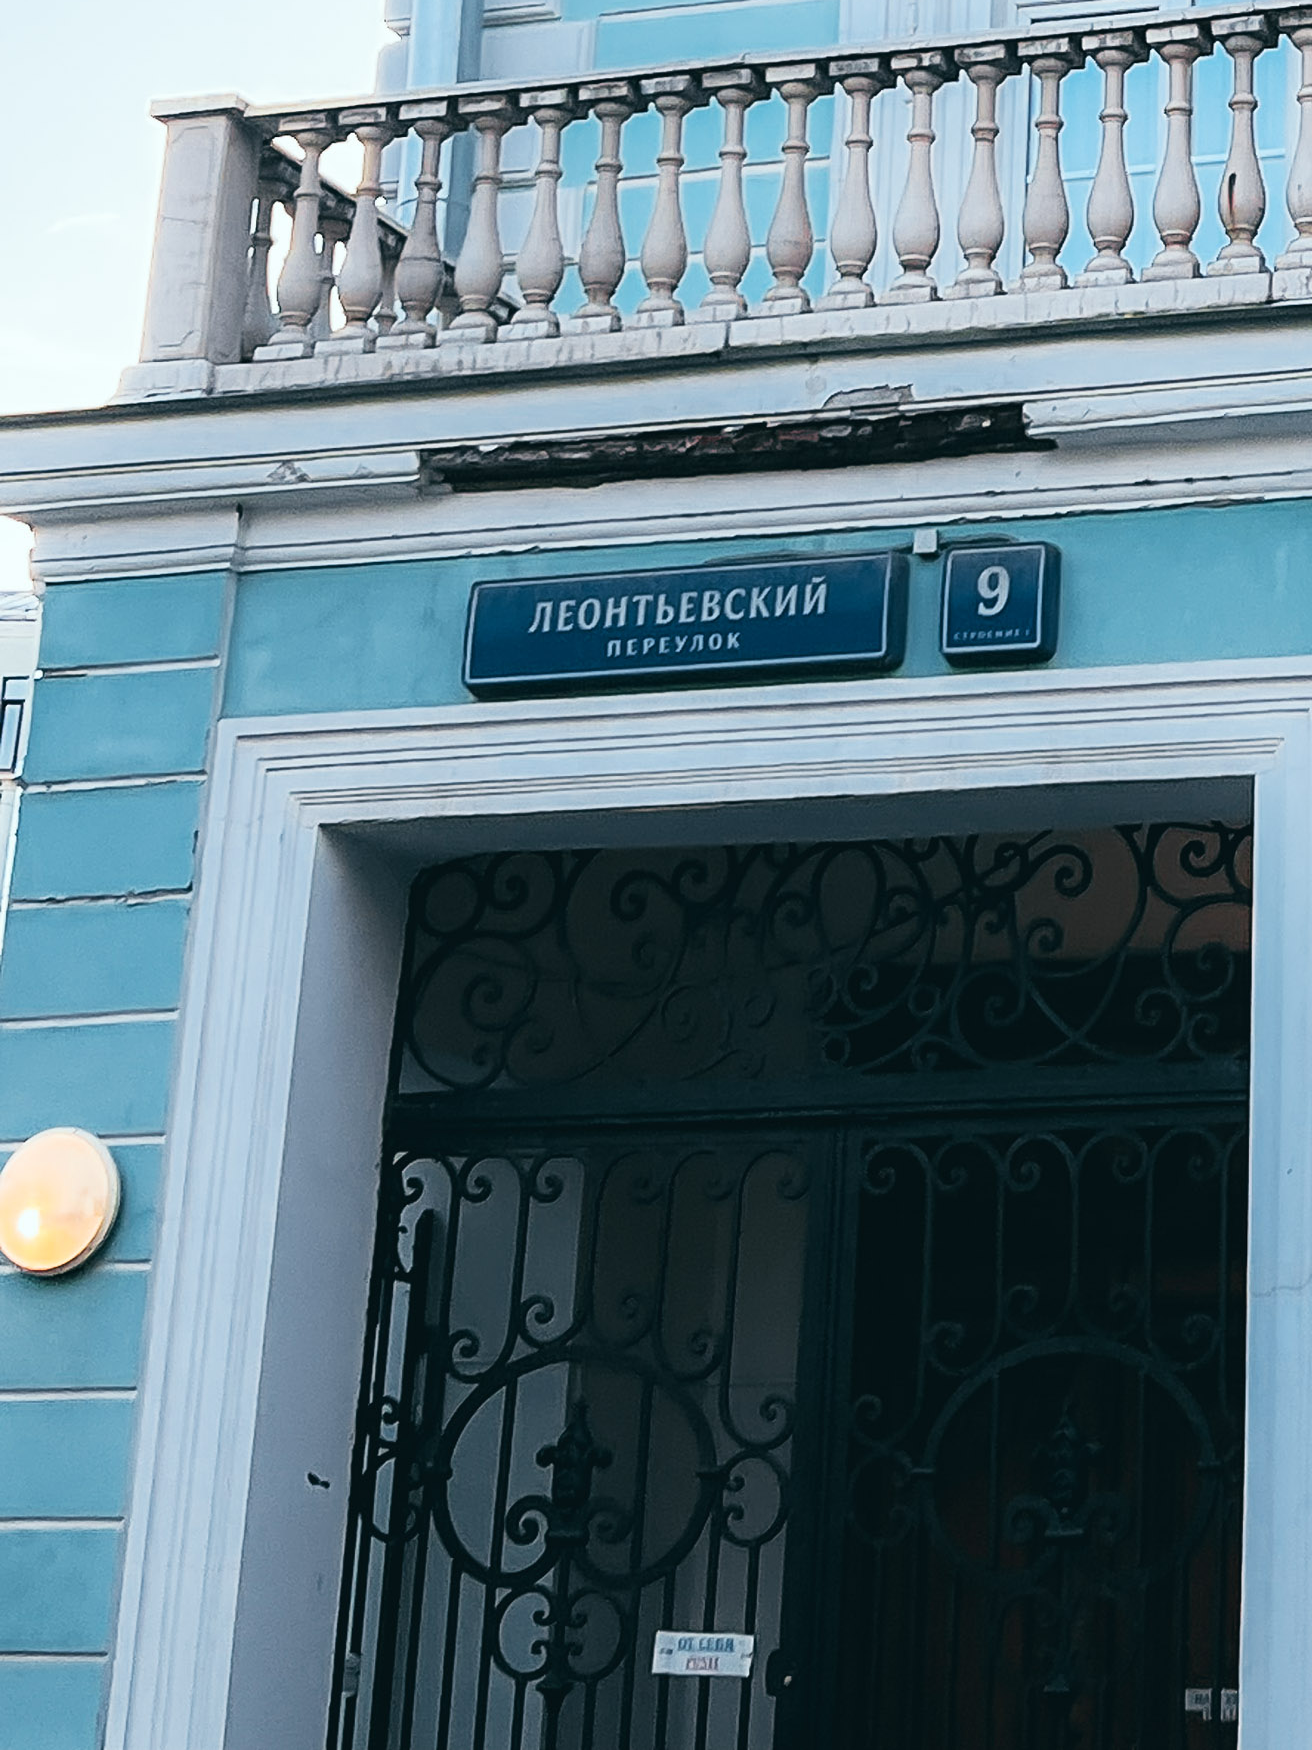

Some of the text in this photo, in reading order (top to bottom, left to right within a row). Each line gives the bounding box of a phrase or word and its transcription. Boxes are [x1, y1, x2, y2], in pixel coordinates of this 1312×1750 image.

[527, 576, 828, 633] ЛЕОНТЬЕВСКИЙ
[977, 565, 1010, 616] 9
[606, 632, 740, 658] ПЕРЕУЛОК
[677, 1637, 694, 1652] ОТ
